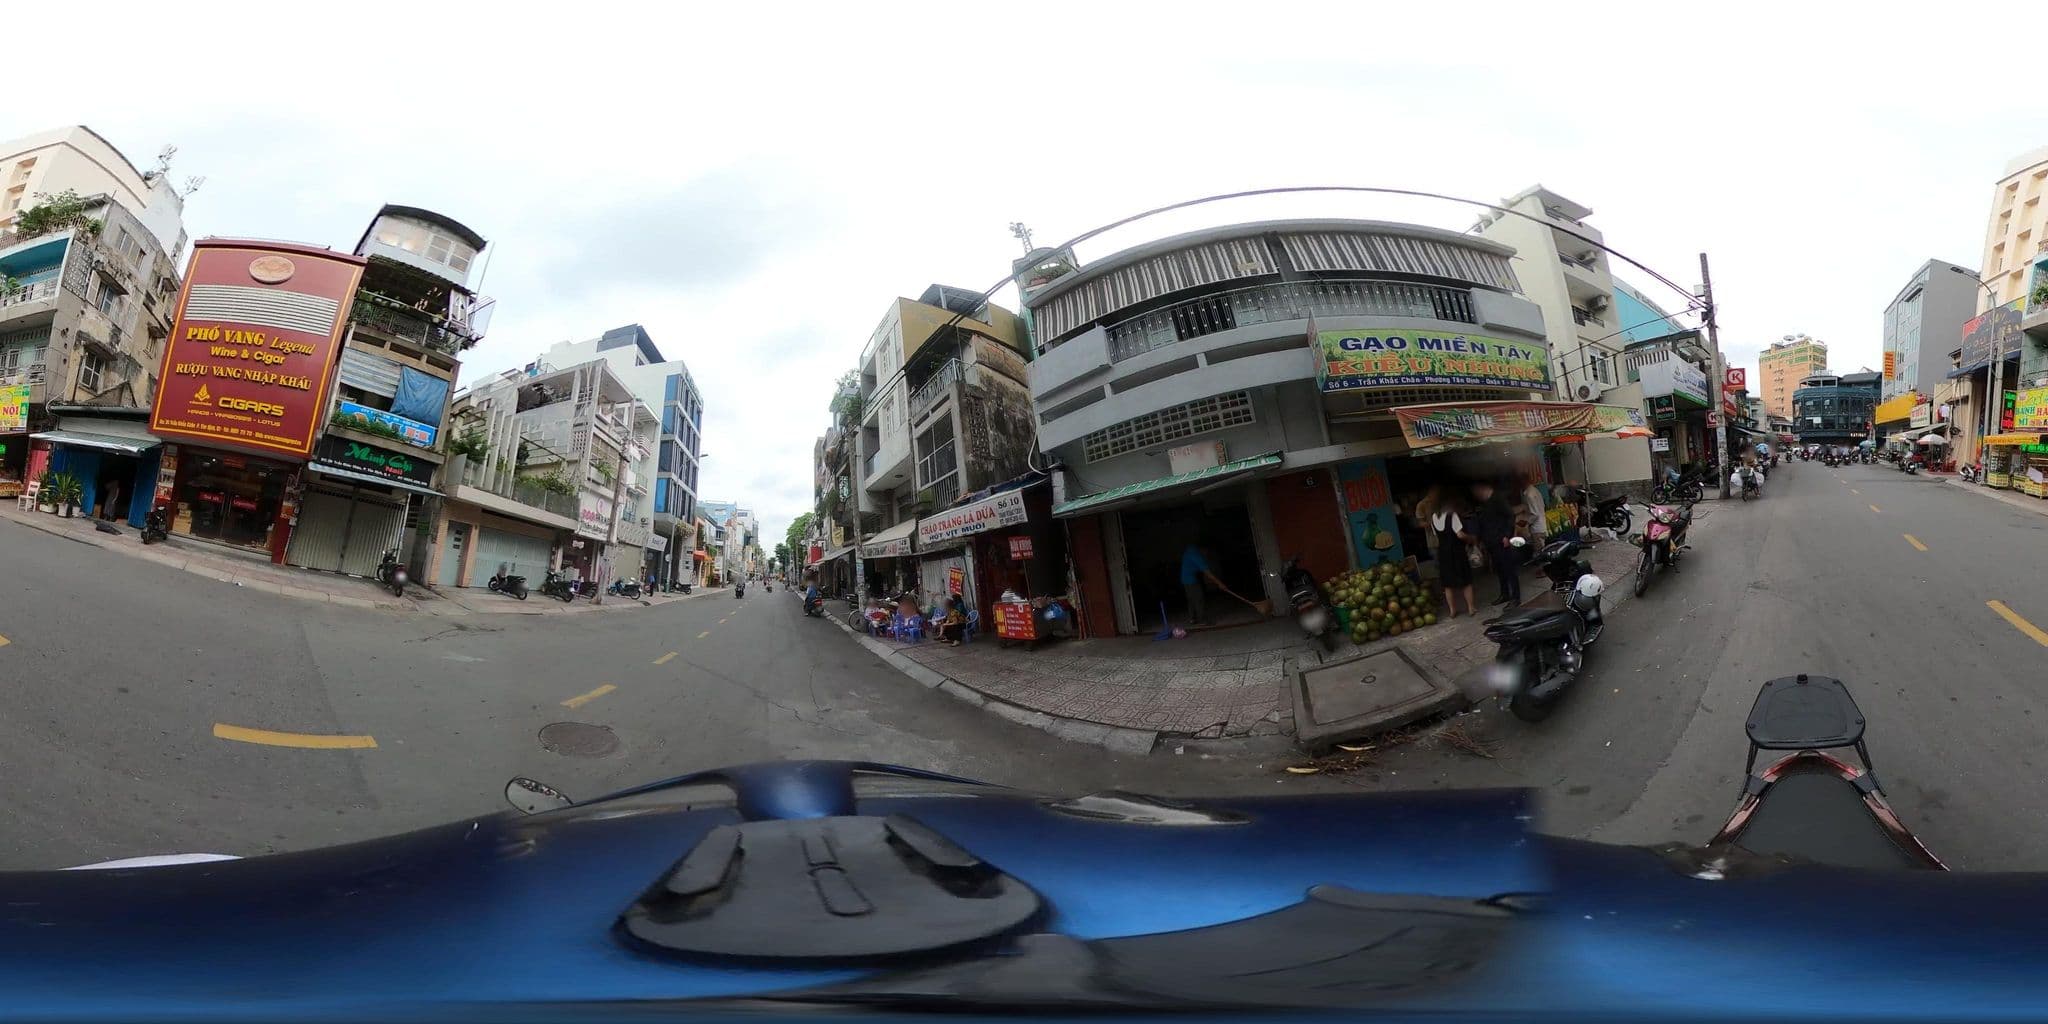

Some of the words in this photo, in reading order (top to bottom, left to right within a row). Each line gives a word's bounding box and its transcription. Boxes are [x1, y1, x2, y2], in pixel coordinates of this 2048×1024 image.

[186, 325, 220, 342] PHỐ
[224, 328, 266, 346] VANG
[270, 337, 316, 356] Legend
[1340, 336, 1407, 352] GẠO
[1418, 335, 1486, 354] MIỀN
[1493, 345, 1531, 360] TÂY
[210, 346, 237, 358] Wine
[240, 350, 249, 358] &
[254, 352, 285, 366] Cigar
[212, 366, 241, 379] VANG
[1328, 380, 1339, 389] Số
[218, 396, 284, 416] CIGARS
[344, 442, 385, 466] Minh
[388, 456, 413, 472] Chi
[384, 466, 403, 475] Nail
[1306, 476, 1314, 486] 6
[998, 498, 1007, 509] Số
[1010, 497, 1019, 506] 10
[946, 530, 958, 538] VỊT
